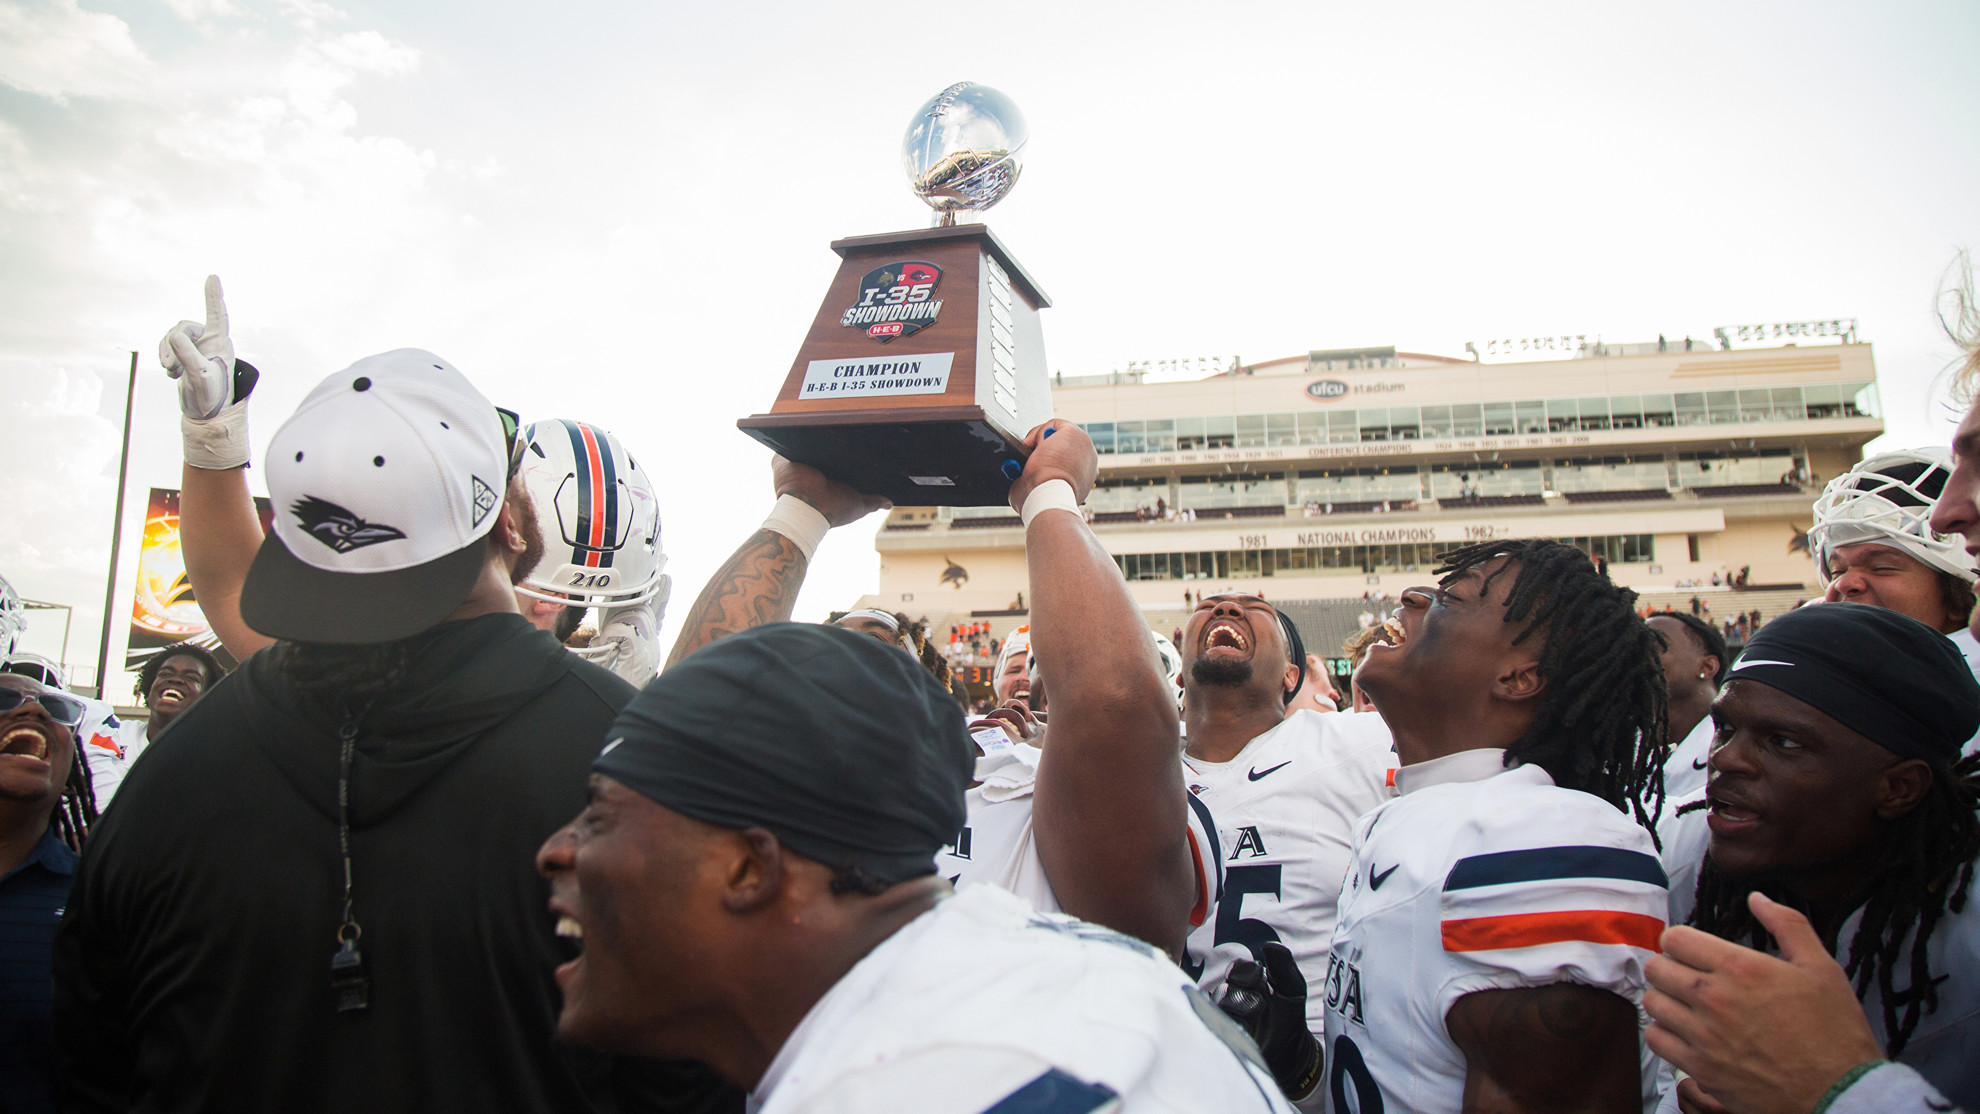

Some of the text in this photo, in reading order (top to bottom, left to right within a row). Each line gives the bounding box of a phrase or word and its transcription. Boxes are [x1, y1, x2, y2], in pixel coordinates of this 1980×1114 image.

[859, 283, 933, 306] I-35
[843, 301, 942, 324] SHOWDOWN
[833, 362, 921, 378] CHAMPION
[806, 377, 943, 393] H-E-B I-35 SHOWDOWN
[1311, 382, 1406, 396] ufcu stadium
[1308, 443, 1412, 458] CONFERENCE CHAMPIONS
[1239, 525, 1495, 548] 1981 NATIONAL CHAMPIONS 1982
[568, 572, 611, 588] 210
